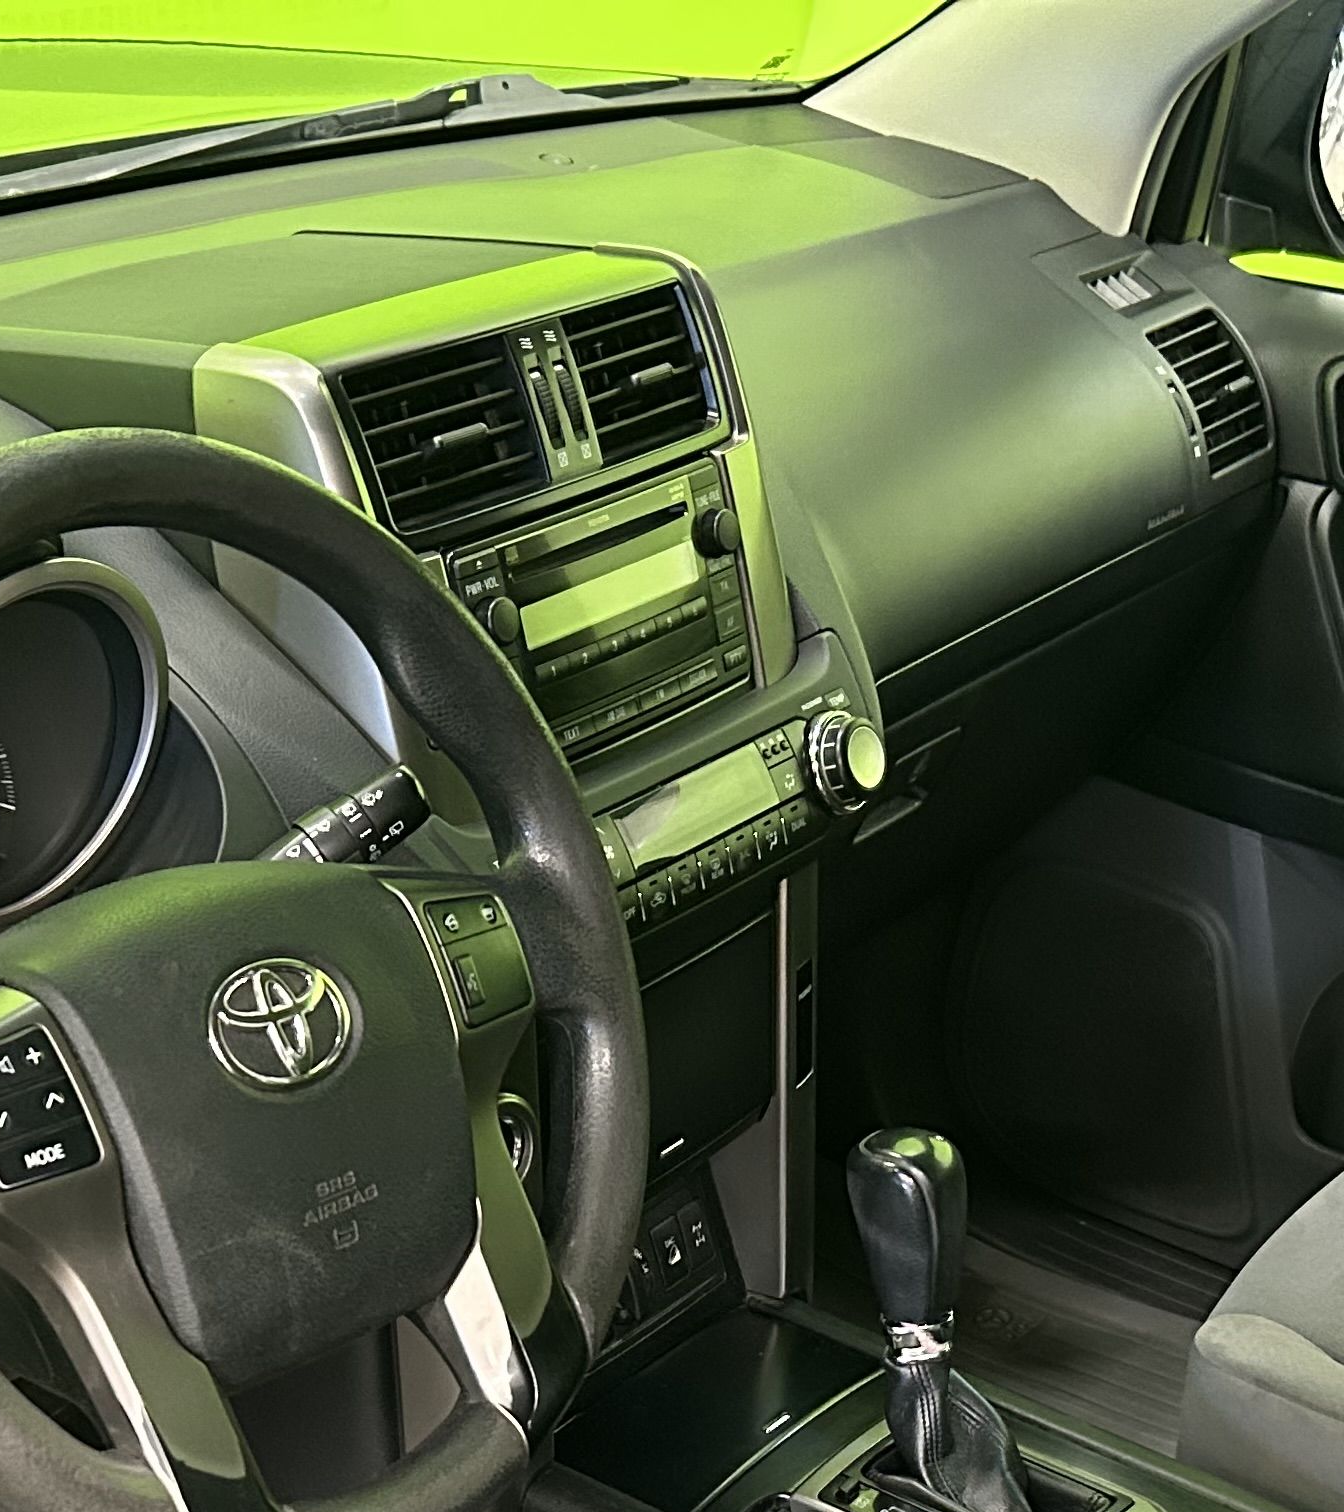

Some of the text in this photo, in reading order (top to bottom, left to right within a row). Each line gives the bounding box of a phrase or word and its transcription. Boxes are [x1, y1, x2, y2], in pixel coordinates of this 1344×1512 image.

[581, 651, 589, 665] 2
[563, 725, 581, 741] TEXT
[24, 1142, 66, 1169] MODE
[316, 1170, 356, 1197] SRS
[303, 1183, 379, 1227] AIRBAG
